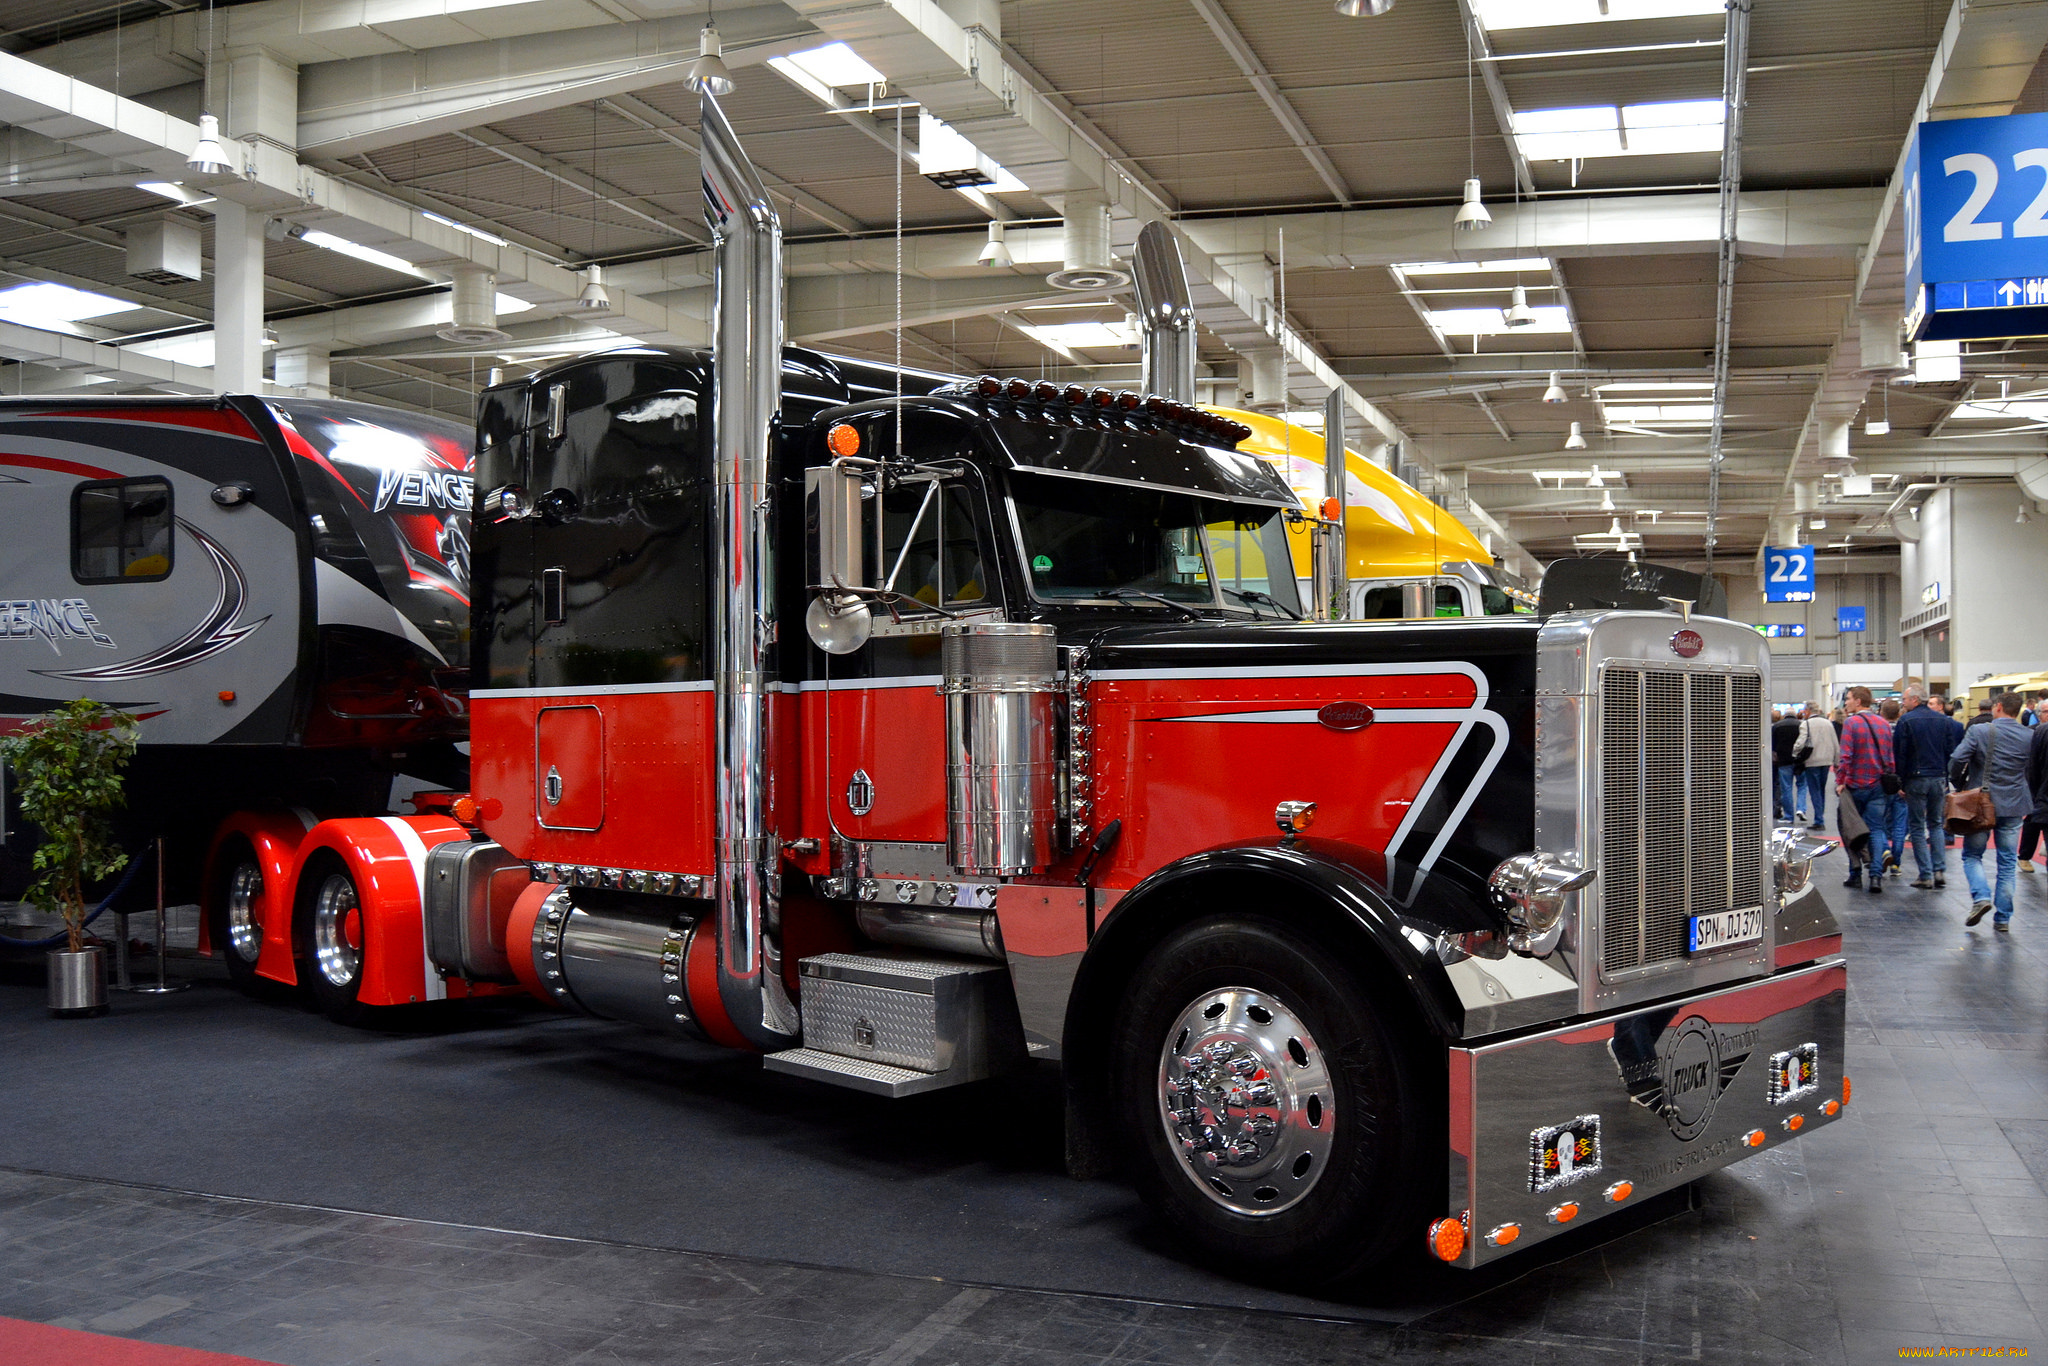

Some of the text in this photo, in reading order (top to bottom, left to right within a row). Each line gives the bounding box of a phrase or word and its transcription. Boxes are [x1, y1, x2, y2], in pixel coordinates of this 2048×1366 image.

[1943, 148, 2048, 242] 22
[1770, 554, 1808, 583] 22
[1323, 706, 1369, 721] Peterbilt
[1698, 917, 1720, 945] SPN
[1727, 913, 1740, 939] DJ
[1720, 1026, 1759, 1053] Promotion
[1673, 1061, 1709, 1096] TRUCK
